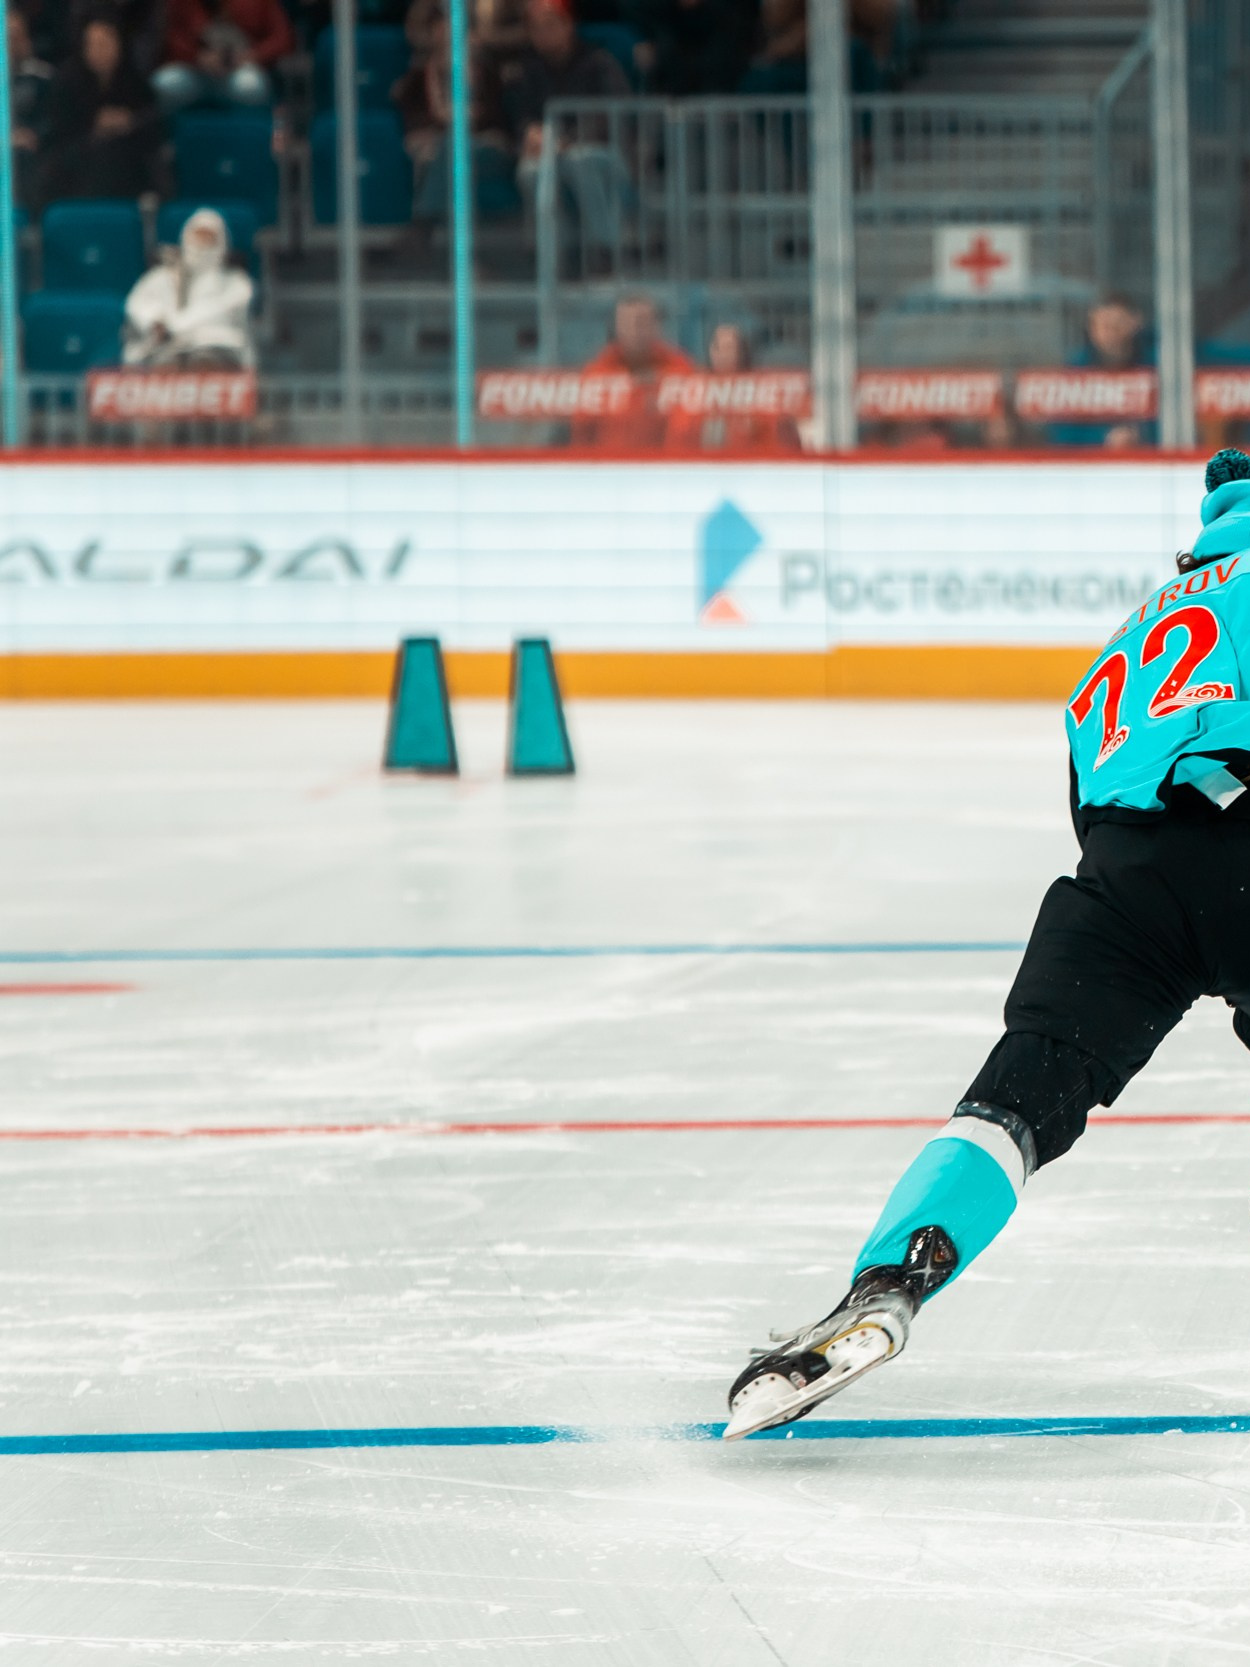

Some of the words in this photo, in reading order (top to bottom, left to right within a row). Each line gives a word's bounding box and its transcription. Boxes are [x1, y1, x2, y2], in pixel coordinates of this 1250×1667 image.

[91, 376, 250, 416] FONBET
[481, 374, 631, 415] FONBET
[657, 374, 806, 414] FONBET
[1017, 373, 1153, 413] FONBET
[780, 551, 1155, 613] Ростелеком
[1068, 605, 1236, 773] 22
